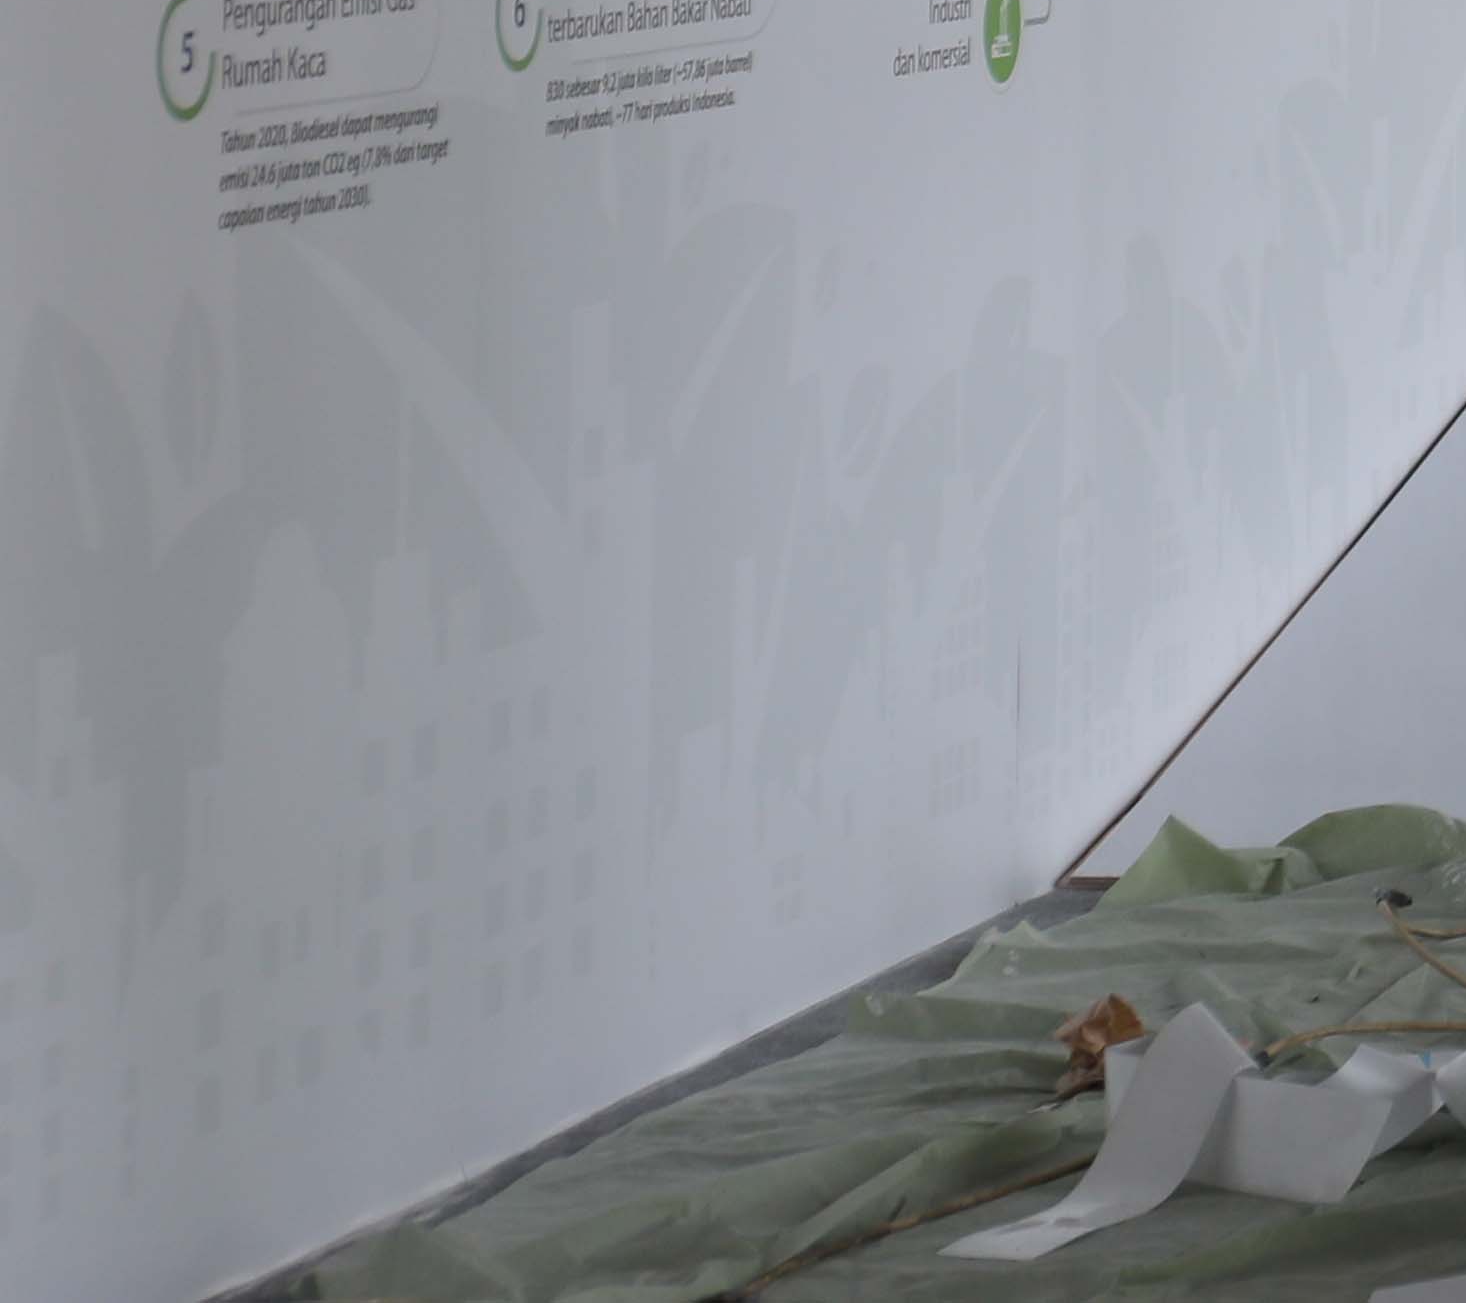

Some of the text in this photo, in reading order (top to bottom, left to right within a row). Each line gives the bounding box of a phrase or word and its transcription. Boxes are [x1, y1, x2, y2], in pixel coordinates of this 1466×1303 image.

[548, 6, 624, 43] terbarukan
[627, 1, 668, 29] Bahan
[181, 30, 194, 73] 5
[222, 46, 326, 90] Rumah Kaca
[893, 34, 971, 79] dan komersial
[220, 129, 256, 154] Tahun
[291, 116, 341, 144] Biodiesel
[372, 102, 440, 129] mengurangi
